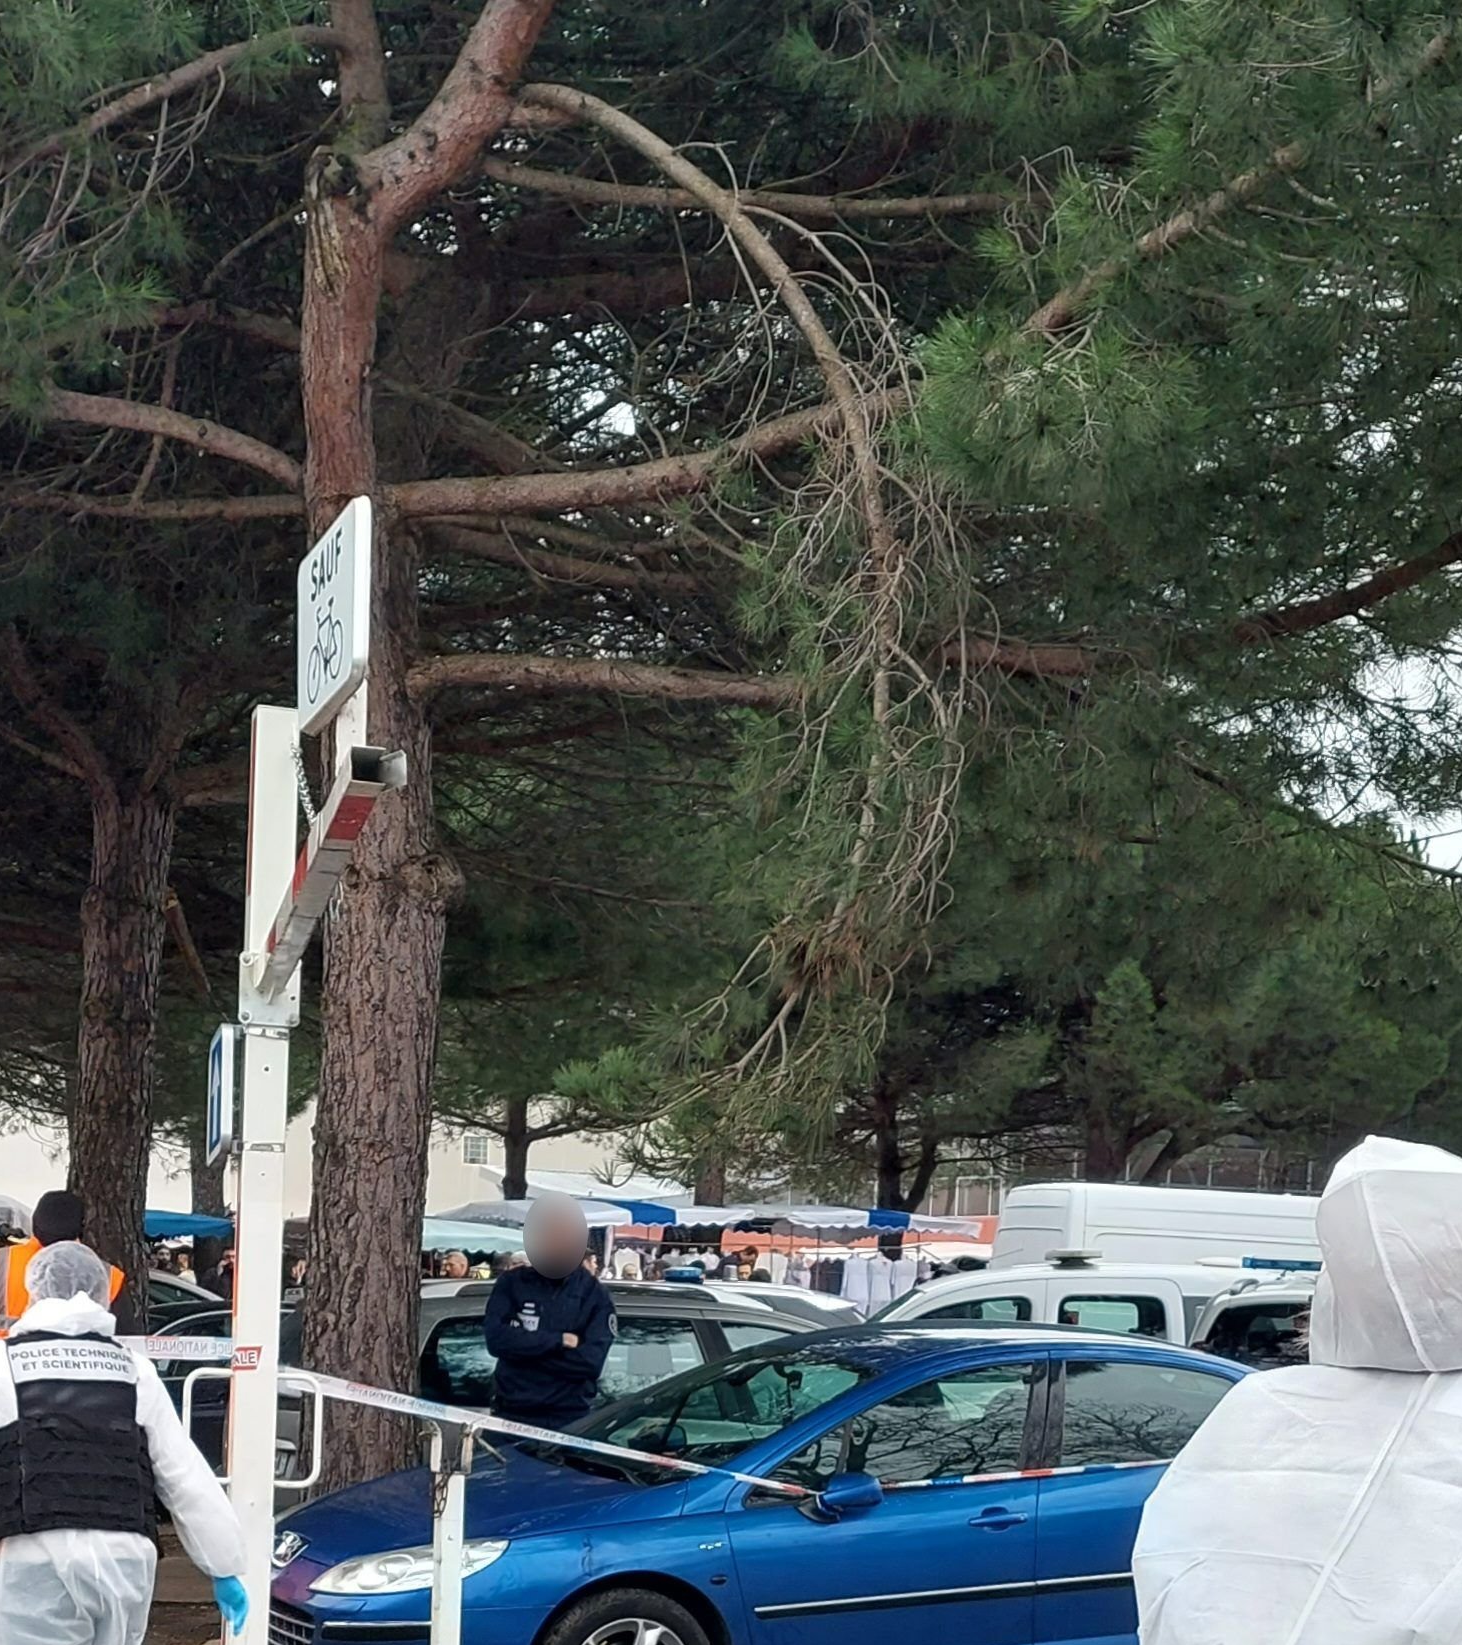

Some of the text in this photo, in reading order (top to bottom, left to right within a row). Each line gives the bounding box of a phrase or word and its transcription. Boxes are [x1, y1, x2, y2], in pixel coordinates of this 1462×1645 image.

[310, 527, 342, 602] SAUF
[11, 1348, 135, 1364] POLICE TECHNIQUE
[22, 1359, 130, 1373] ET SCIENTIFIQUE
